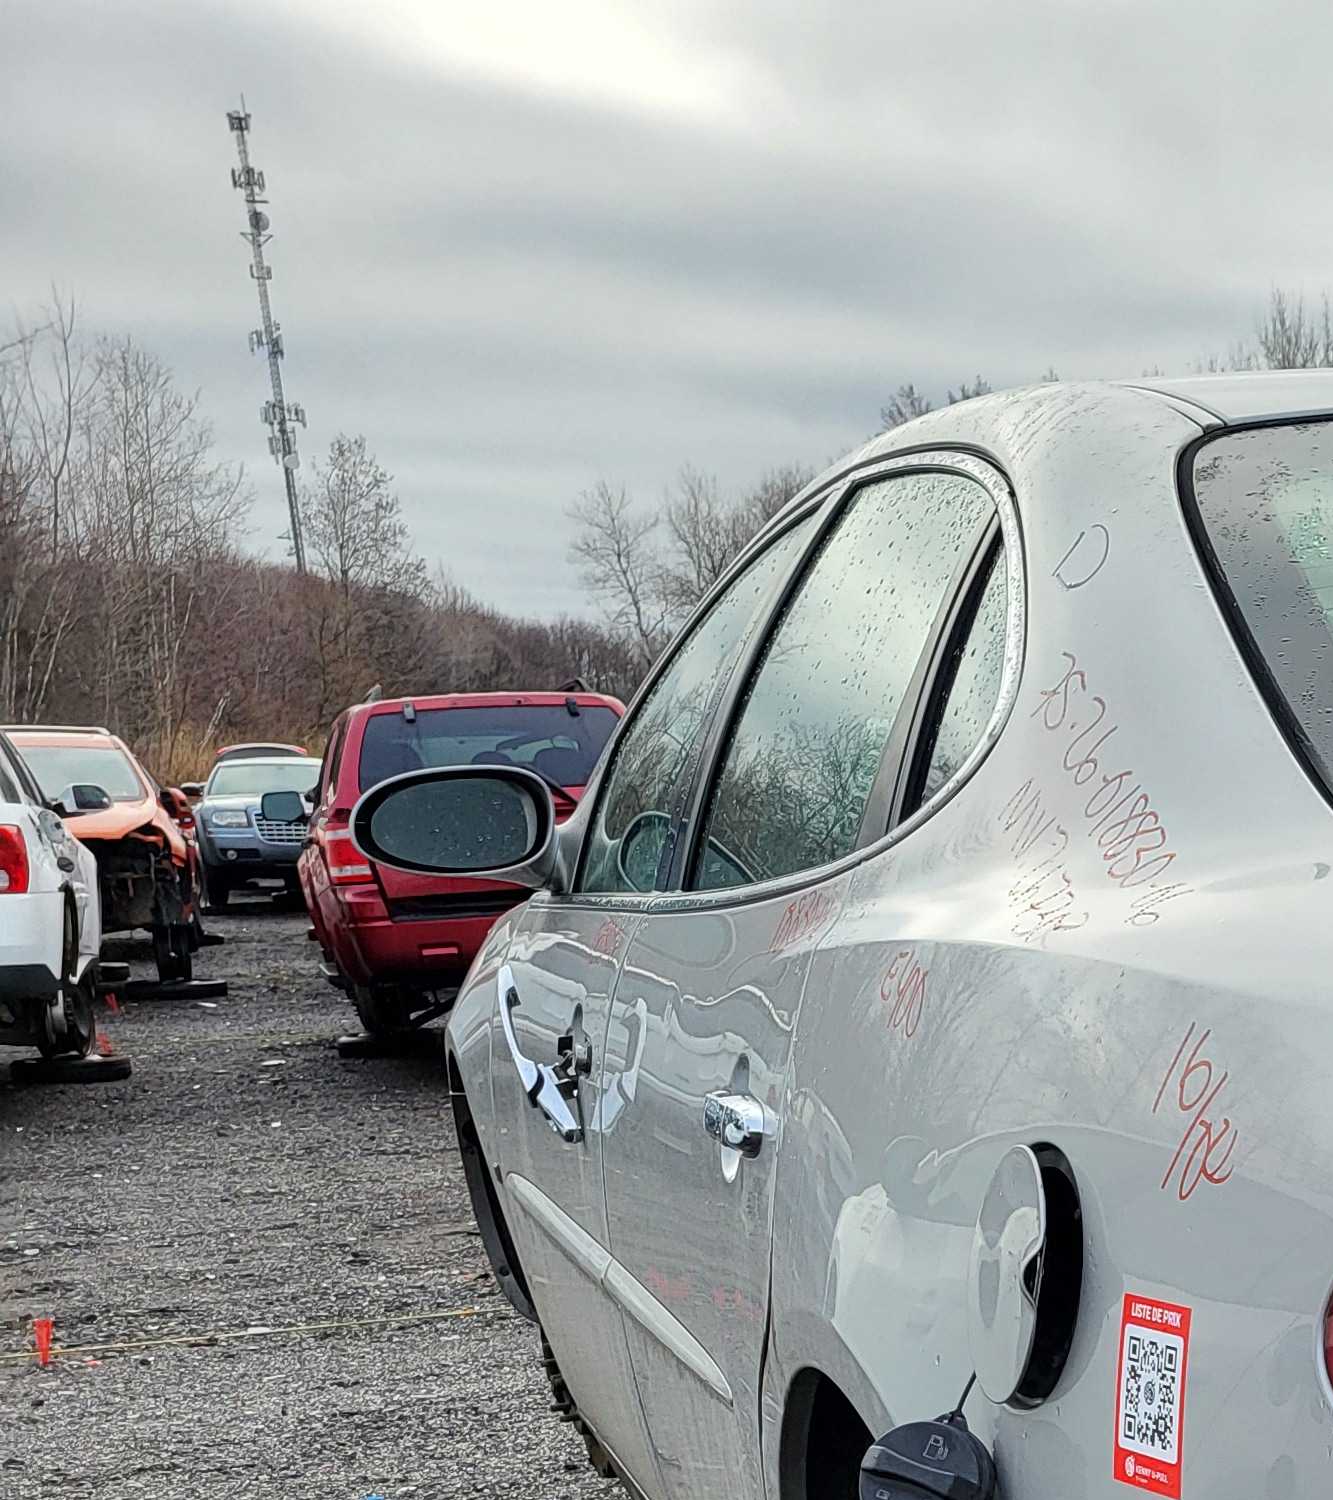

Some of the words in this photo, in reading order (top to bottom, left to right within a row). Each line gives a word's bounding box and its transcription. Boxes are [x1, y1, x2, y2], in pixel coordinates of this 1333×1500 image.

[1131, 1302, 1153, 1321] LISTE
[1152, 1307, 1164, 1323] DE
[1163, 1310, 1182, 1329] PRIX
